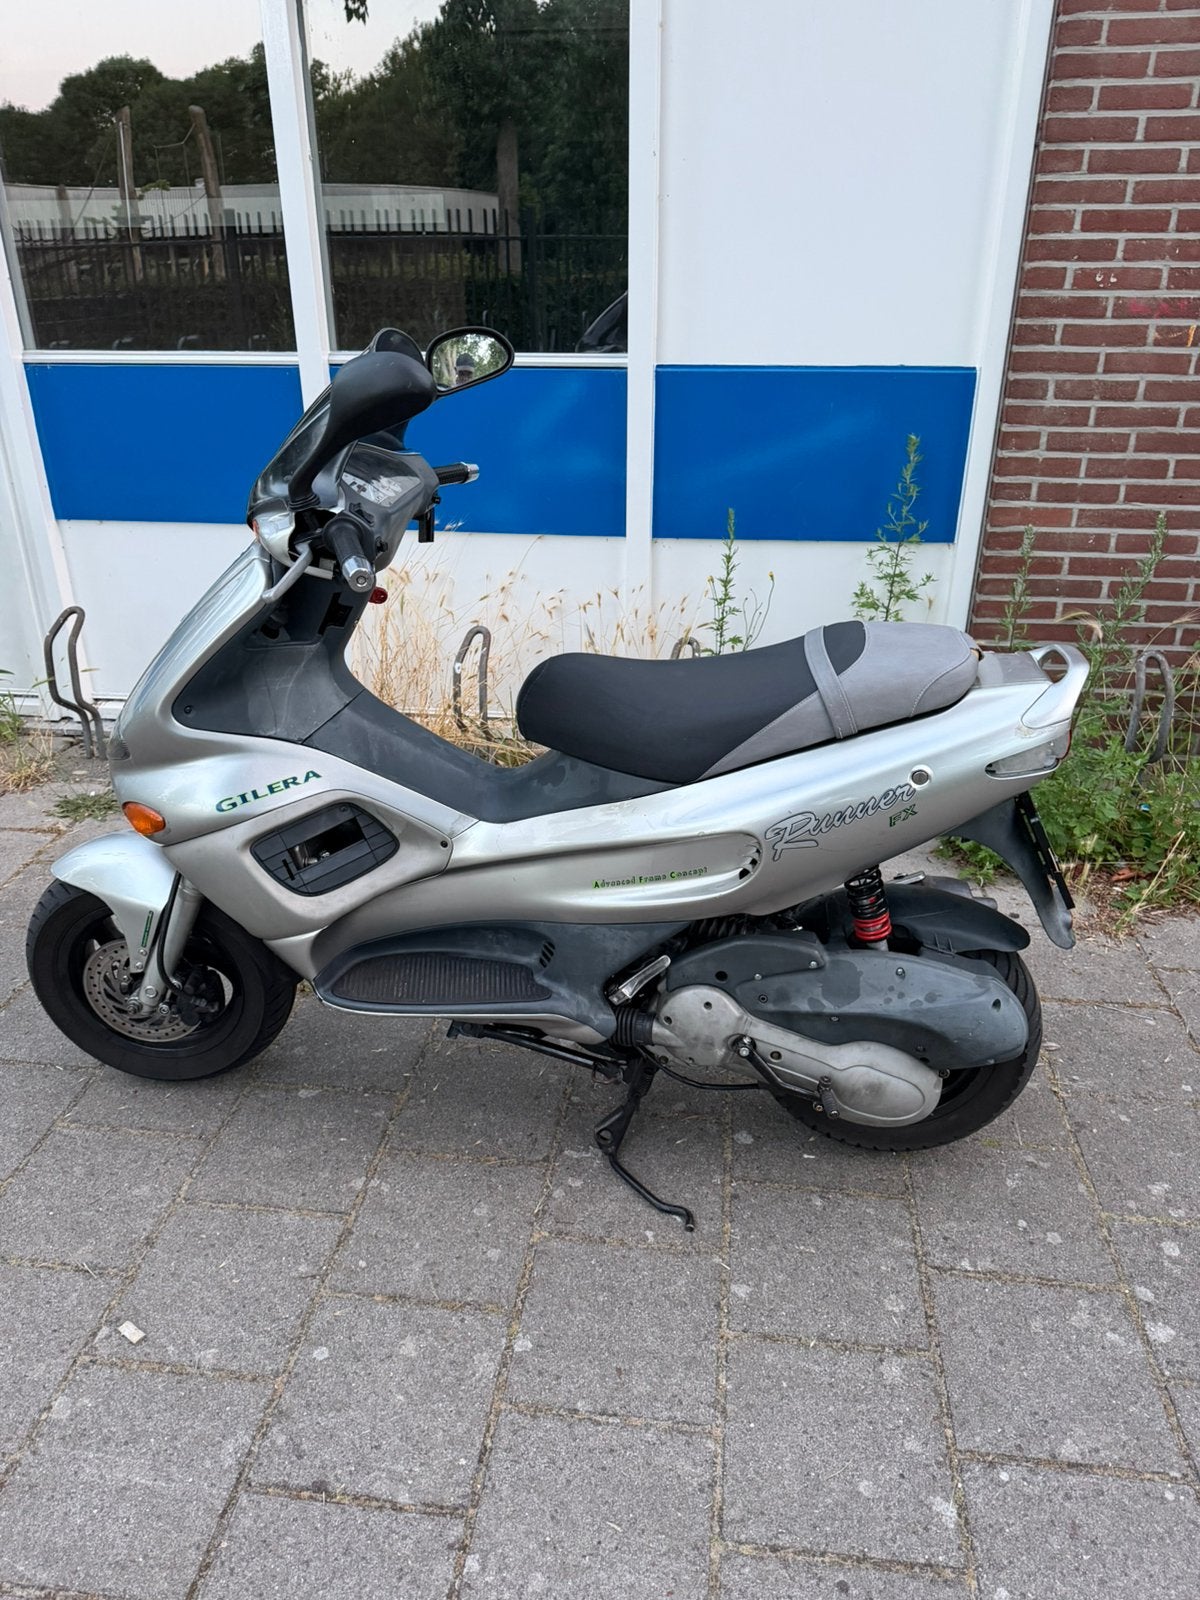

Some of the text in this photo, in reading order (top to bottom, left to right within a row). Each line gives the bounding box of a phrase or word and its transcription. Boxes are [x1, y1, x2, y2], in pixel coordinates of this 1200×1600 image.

[216, 770, 322, 813] GILERA
[764, 783, 917, 862] Runner
[889, 804, 918, 828] FX
[593, 876, 636, 889] Advanced
